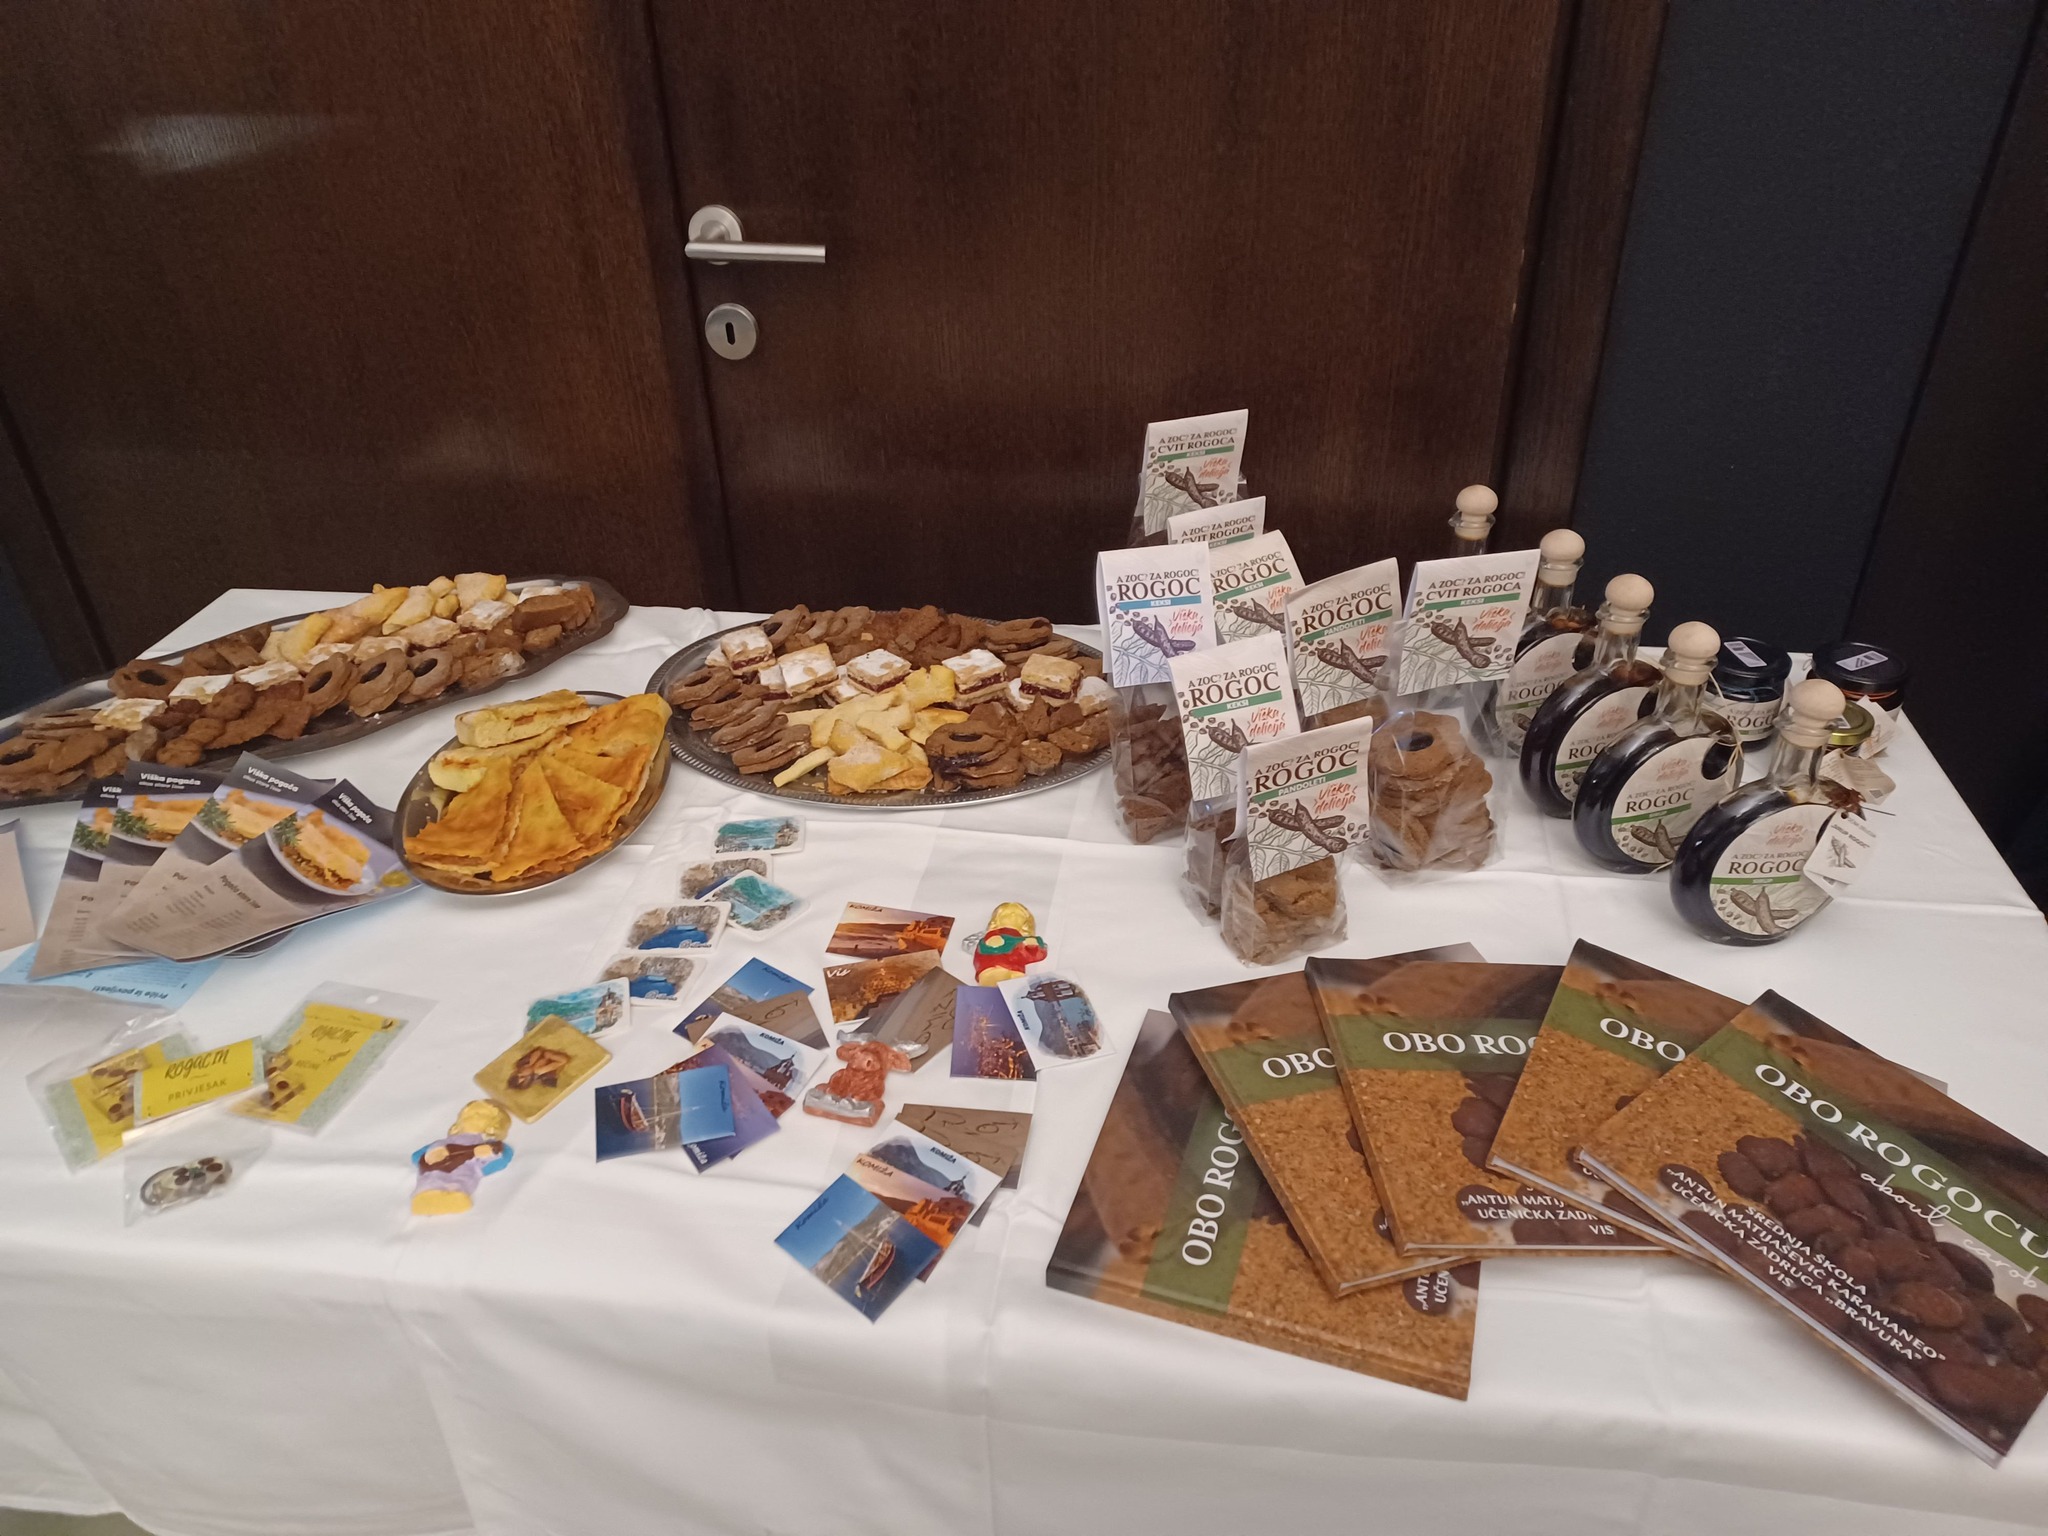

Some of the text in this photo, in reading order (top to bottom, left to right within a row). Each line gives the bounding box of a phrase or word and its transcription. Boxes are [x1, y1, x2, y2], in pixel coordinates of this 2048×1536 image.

[1157, 436, 1236, 454] CVIT ROGOCA
[1209, 524, 1255, 540] ROGOCA
[1213, 558, 1289, 594] ROGOC
[1117, 577, 1201, 602] ROGOC
[1426, 581, 1522, 601] CVIT ROGOCA
[1302, 592, 1393, 634] ROGOC
[1324, 617, 1366, 637] PANDOLETI
[1189, 671, 1281, 708] ROGOC
[1255, 749, 1360, 794] ROGOC
[101, 786, 122, 795] Višk
[1278, 776, 1327, 797] PANDOLETI
[1625, 789, 1695, 813] ROGOC
[1728, 858, 1807, 875] ROGOC
[1382, 1031, 1467, 1054] OBO
[1599, 1016, 1688, 1063] OBO
[1262, 1047, 1338, 1079] OBO
[168, 1080, 227, 1103] PRIVJESAK
[1755, 1064, 2048, 1259] OBO ROGOCU
[1182, 1110, 1244, 1267] OBO ROG
[1860, 1173, 1963, 1228] about
[1477, 1207, 1555, 1220] UČENIČKA
[1588, 1224, 1616, 1235] VIS
[1671, 1182, 1746, 1239] UČENIČKA
[1746, 1239, 1825, 1296] ZADRUGA
[1727, 1207, 1828, 1280] MATIJAŠEVIĆ
[1744, 1205, 1867, 1296] SREDNJA ŠKOLA
[1767, 1264, 1796, 1288] VIS
[1963, 1238, 2040, 1289] carob
